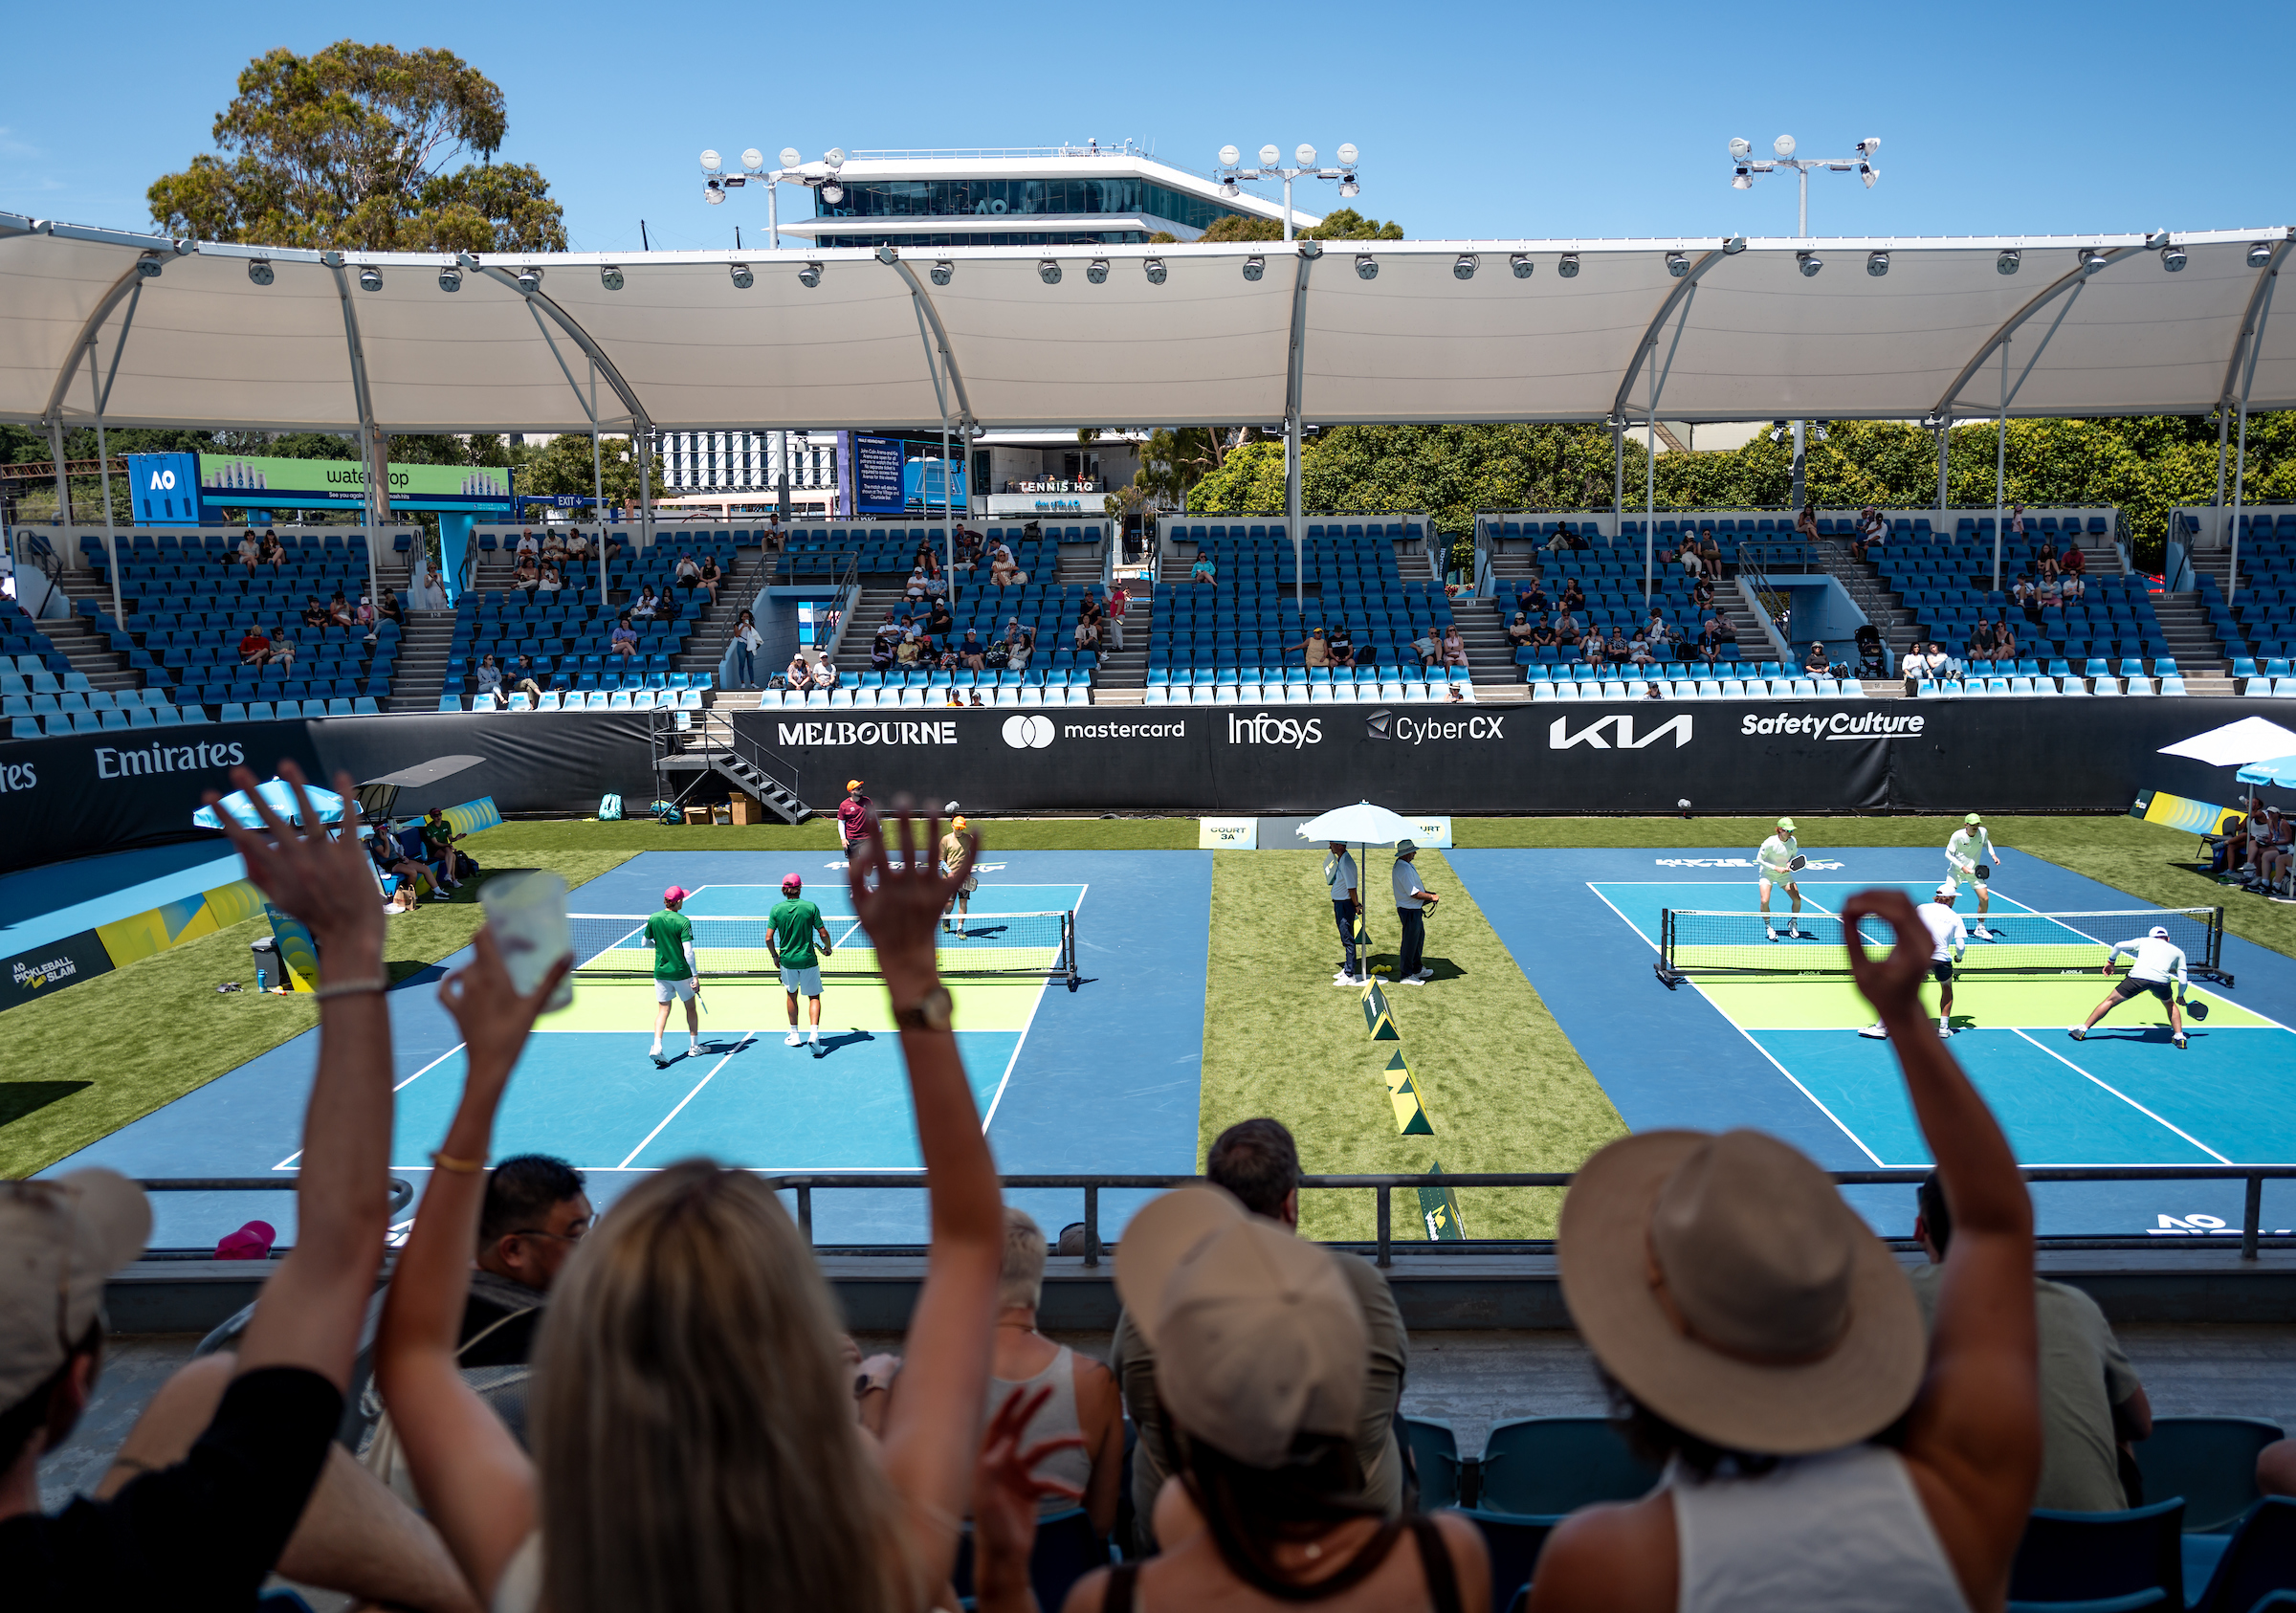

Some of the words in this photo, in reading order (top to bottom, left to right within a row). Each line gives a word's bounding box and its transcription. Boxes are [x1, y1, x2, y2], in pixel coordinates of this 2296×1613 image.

[974, 199, 1007, 214] AO
[150, 470, 176, 490] AO
[1019, 482, 1069, 492] TENNIS
[1074, 482, 1093, 492] HQ
[558, 496, 574, 506] EXIT
[778, 721, 957, 745] MELBOURNE
[1064, 720, 1185, 740] mastercard
[1228, 712, 1323, 749] Infosys
[1396, 716, 1504, 745] CyberCX
[1549, 714, 1693, 750] KIA
[1740, 712, 1925, 740] SafetyCulture
[94, 740, 245, 779] Emirates
[13, 961, 26, 973] AO
[13, 957, 73, 983] PICKLEBALL
[46, 964, 77, 982] SLAM
[2158, 1214, 2226, 1229] AO
